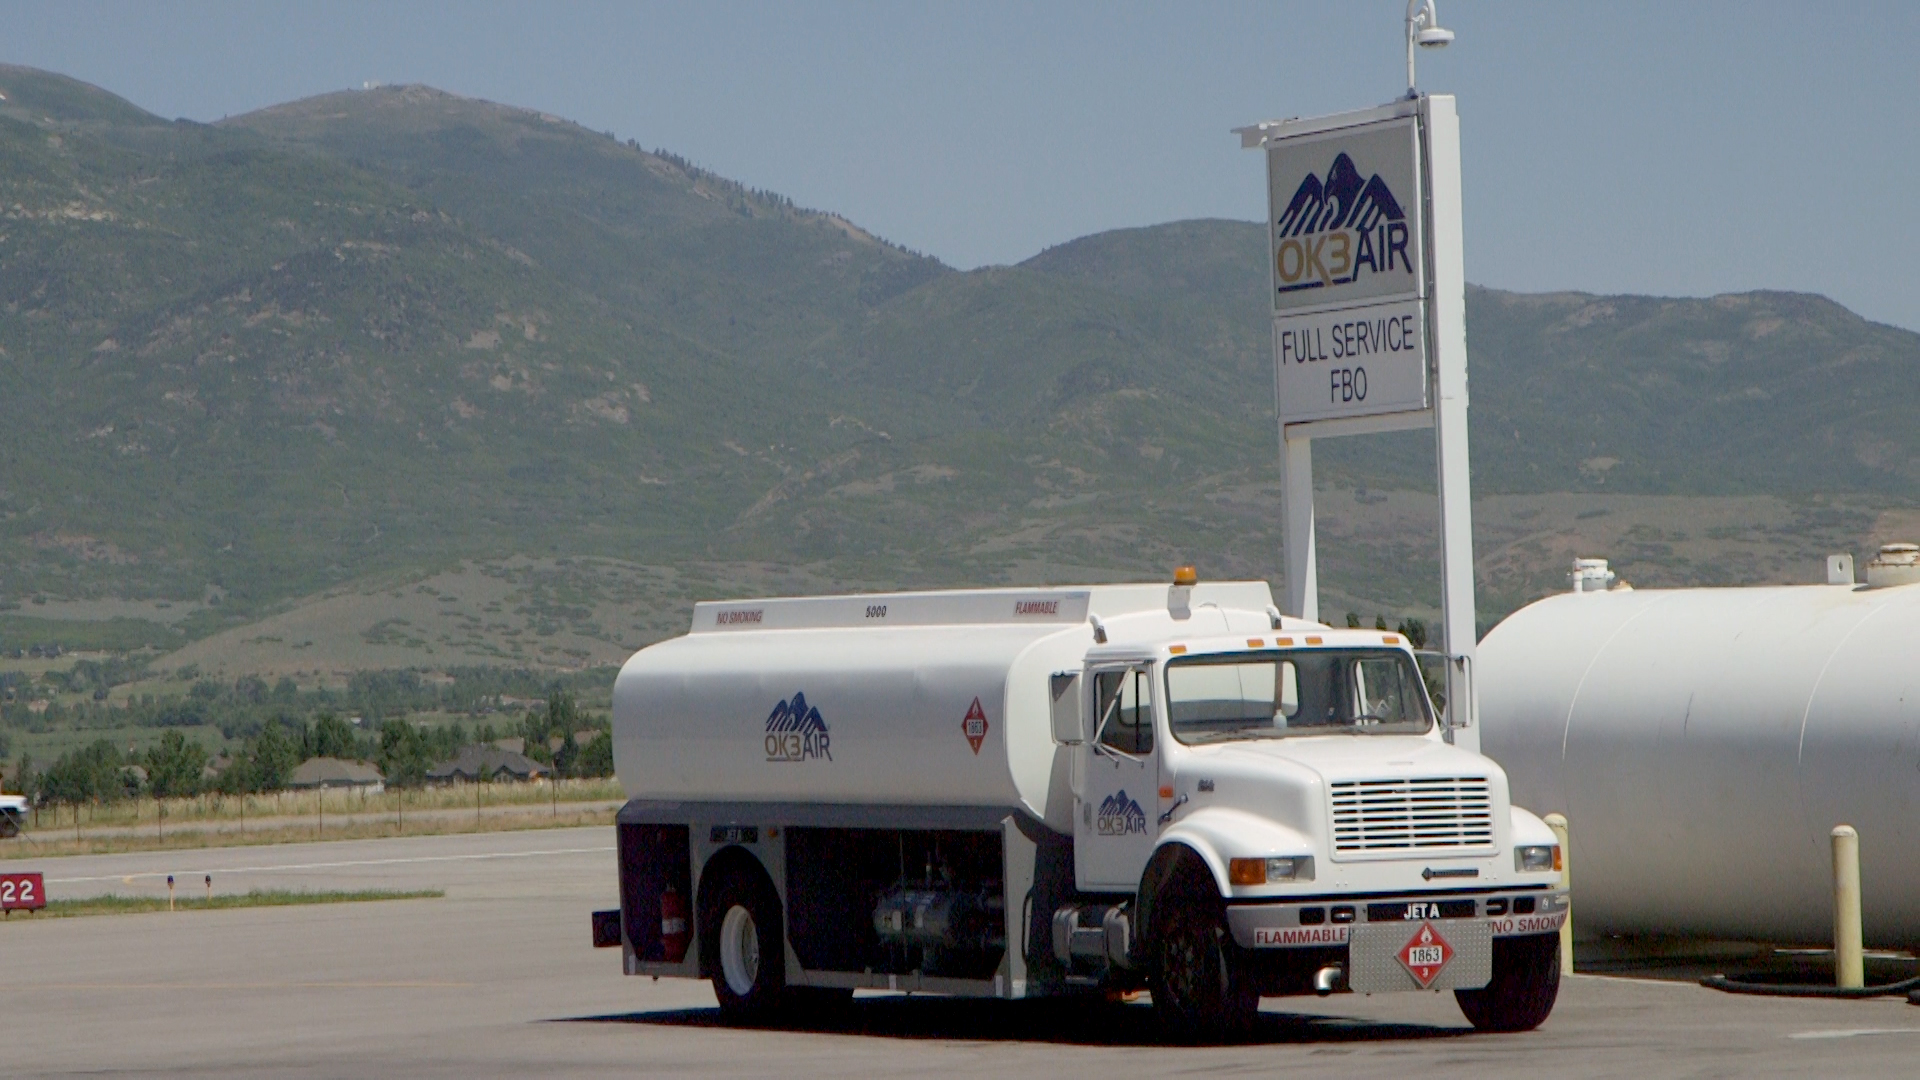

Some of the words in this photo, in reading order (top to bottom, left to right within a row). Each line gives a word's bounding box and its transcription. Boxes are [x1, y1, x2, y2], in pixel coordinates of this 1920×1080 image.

[1281, 329, 1329, 365] FULL
[1332, 315, 1414, 358] SERVICE
[1330, 366, 1367, 403] FBO
[865, 605, 887, 618] 5000
[1015, 601, 1058, 614] FLAMMABLE
[729, 610, 763, 624] SMOKING
[1, 880, 35, 902] 22
[1404, 903, 1428, 920] JET
[1429, 903, 1440, 918] A
[1492, 919, 1513, 933] NO
[1518, 912, 1568, 932] SMOKIN
[1256, 927, 1346, 944] FLAMMABLE
[1412, 948, 1440, 963] 1863
[1422, 967, 1429, 978] 3
